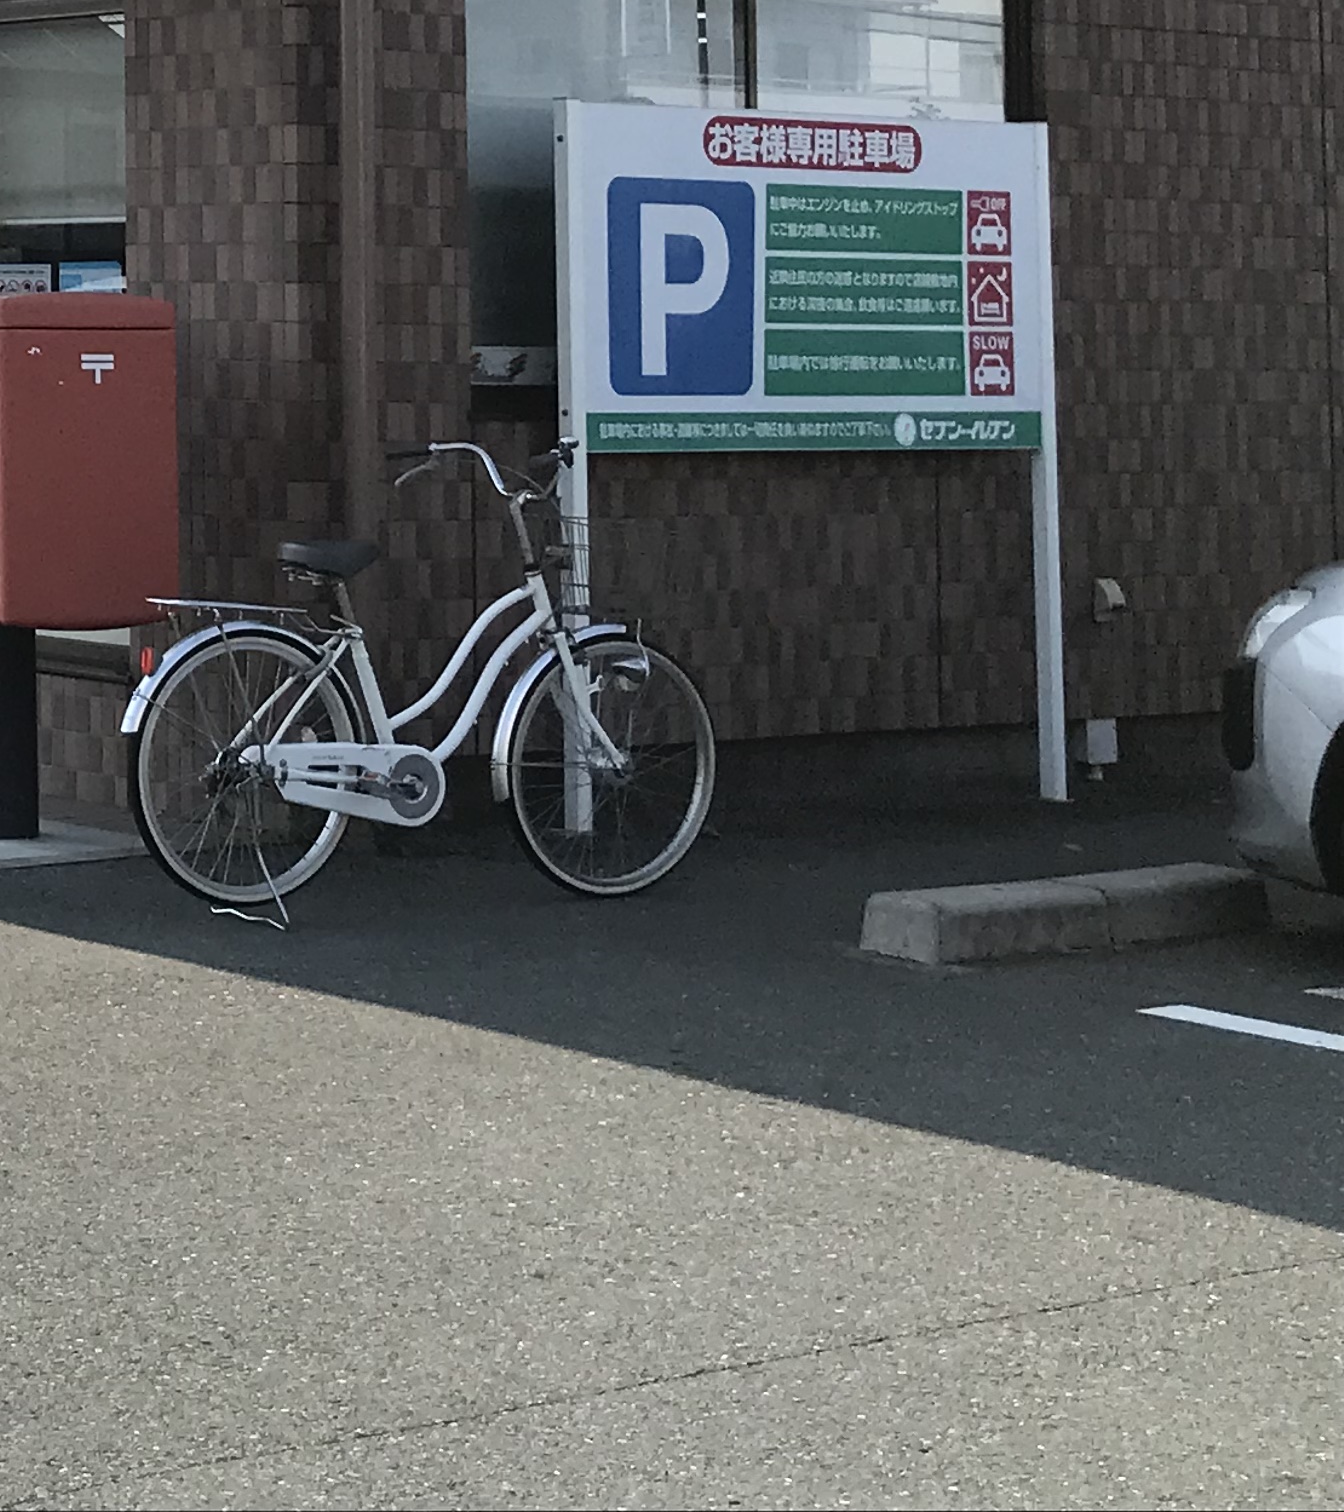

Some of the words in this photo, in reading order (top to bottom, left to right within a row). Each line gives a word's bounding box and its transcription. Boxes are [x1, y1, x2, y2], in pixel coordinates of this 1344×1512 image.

[707, 122, 916, 170] お客様専用駐車場
[639, 203, 731, 377] P
[972, 336, 1010, 351] SLOW
